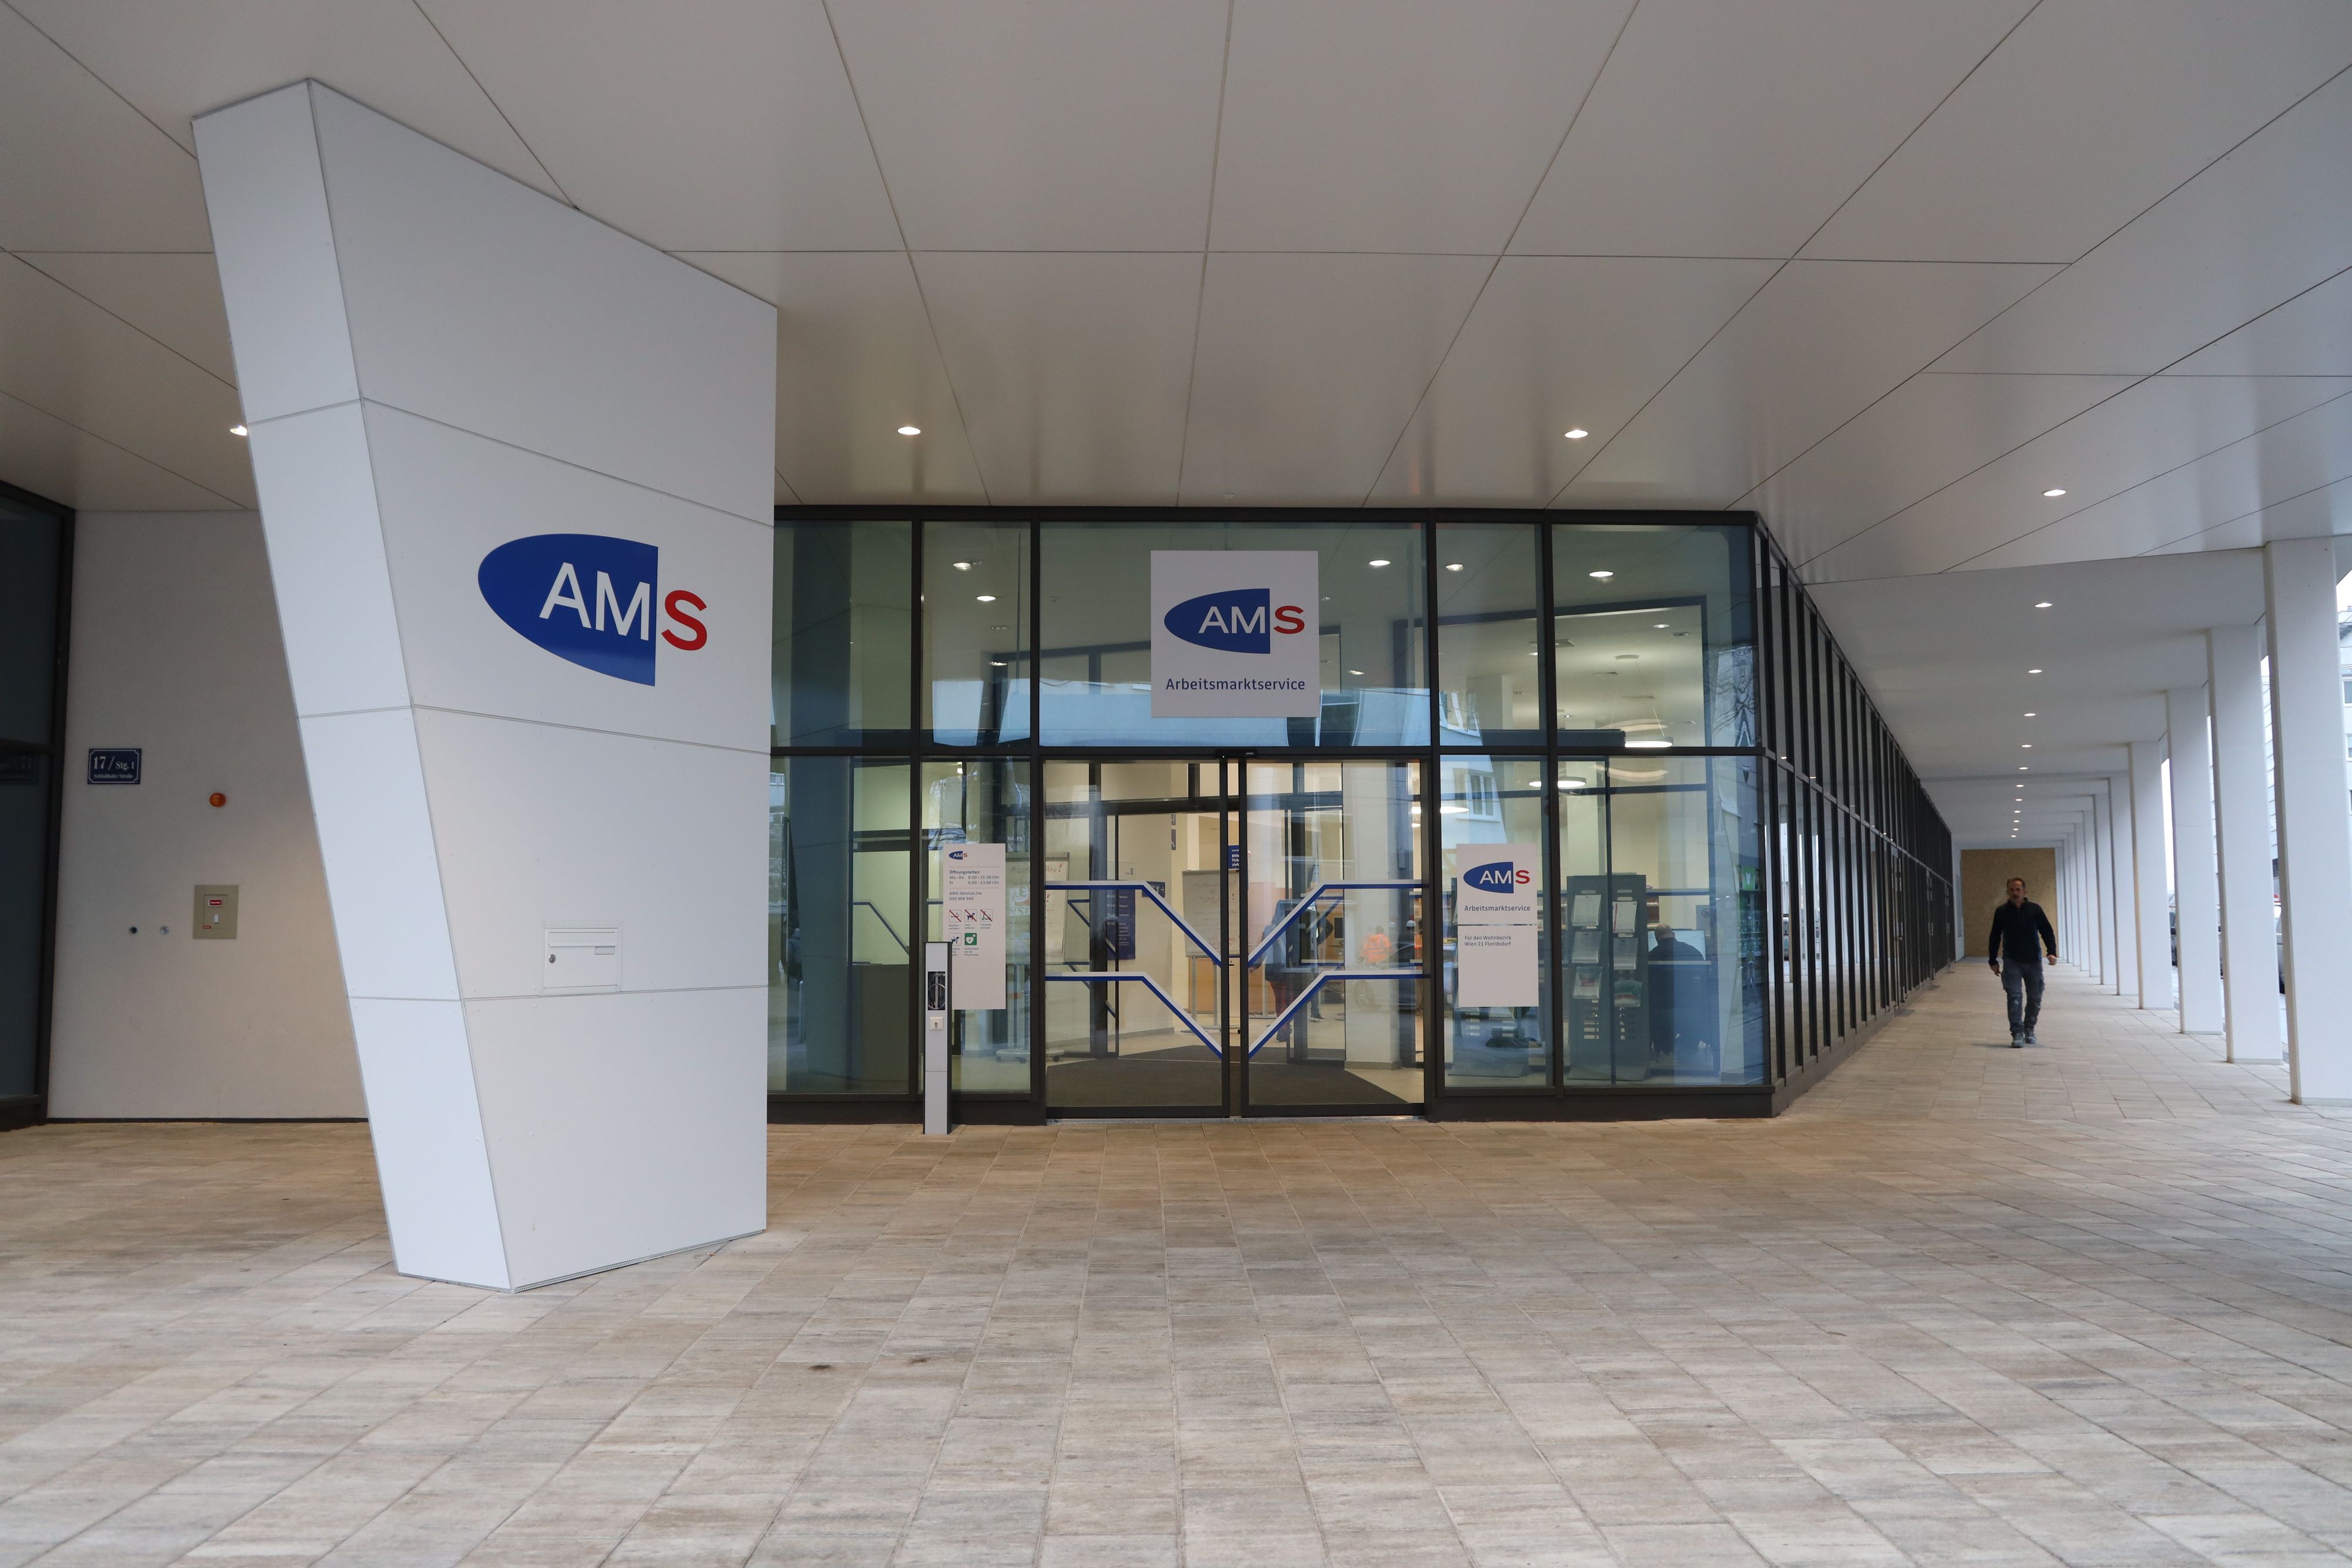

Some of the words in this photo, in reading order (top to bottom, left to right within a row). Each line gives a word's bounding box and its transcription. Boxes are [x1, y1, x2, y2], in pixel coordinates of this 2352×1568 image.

[539, 561, 707, 651] AMS
[1198, 606, 1305, 634] AMS
[1166, 678, 1305, 690] Arbeitsmarktservice
[93, 756, 106, 769] 17
[115, 761, 129, 771] Stg.
[131, 761, 135, 770] 1
[1479, 870, 1531, 884] AMS
